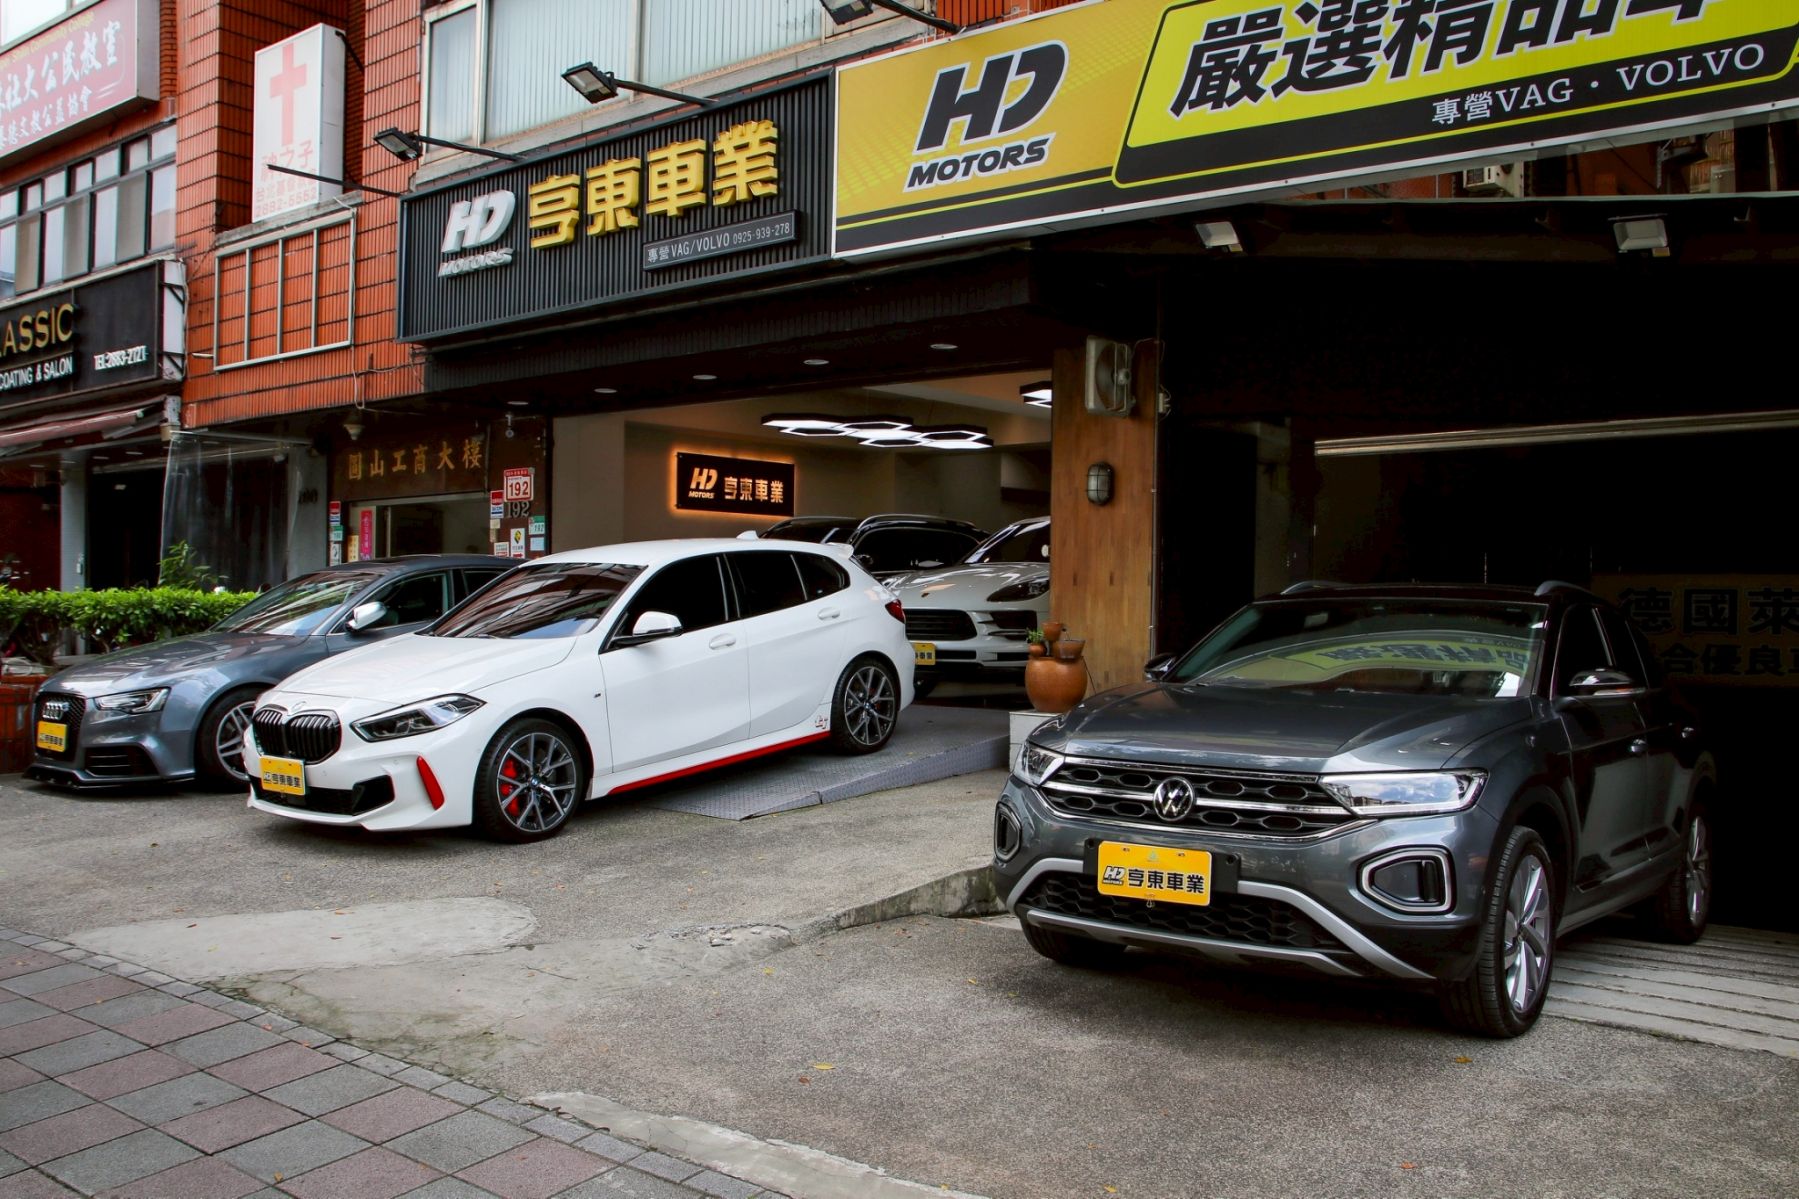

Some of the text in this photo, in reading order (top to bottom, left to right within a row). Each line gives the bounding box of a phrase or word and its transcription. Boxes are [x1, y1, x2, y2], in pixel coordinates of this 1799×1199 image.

[1616, 44, 1764, 90] VOLVO
[914, 42, 1067, 152] HD
[907, 138, 1051, 188] MOTORS
[529, 119, 778, 249] 亨東車業
[441, 189, 516, 254] HD
[671, 232, 730, 257] VAG/VOLVO
[732, 222, 790, 244] 0925-939-278
[438, 247, 515, 277] MOTORS
[0, 303, 74, 357] ASSIC
[35, 363, 42, 383] &
[43, 355, 73, 382] SALON
[509, 480, 529, 497] 192
[689, 467, 718, 491] HD
[724, 476, 784, 504] 亨東車業
[506, 501, 530, 518] 192
[1128, 868, 1205, 894] 亨東車業
